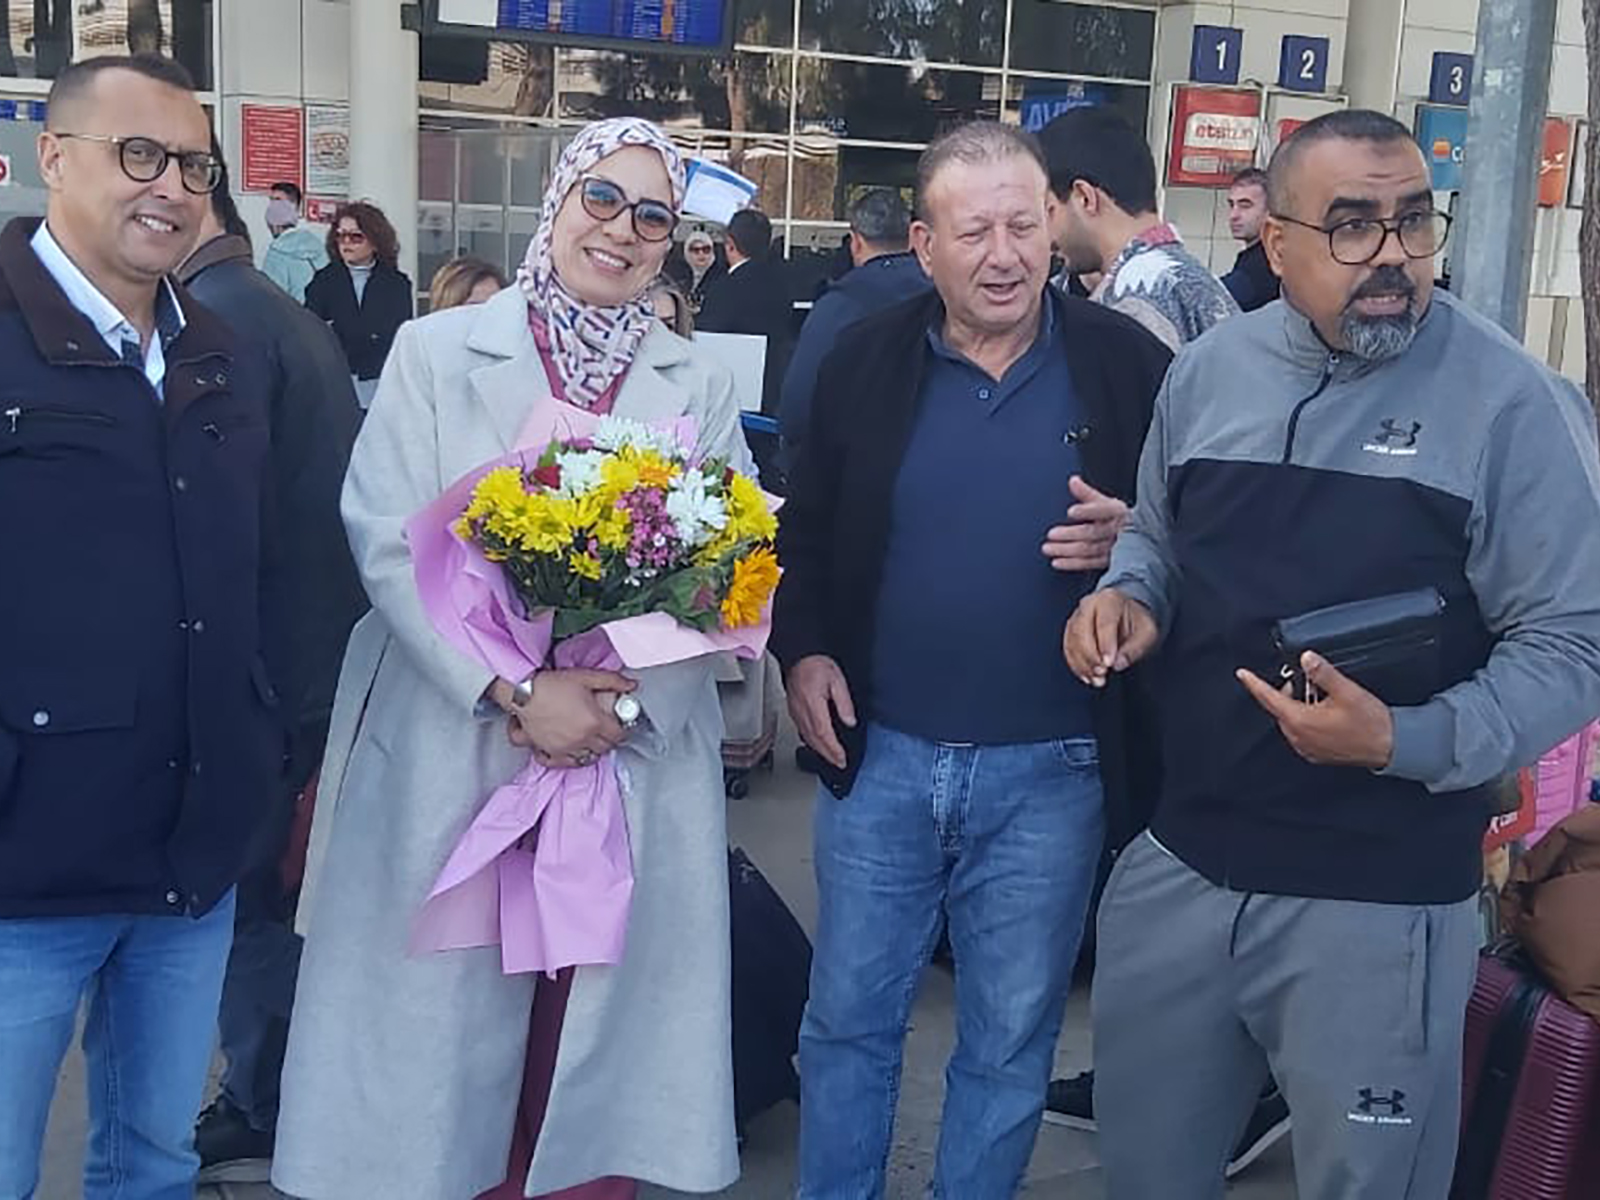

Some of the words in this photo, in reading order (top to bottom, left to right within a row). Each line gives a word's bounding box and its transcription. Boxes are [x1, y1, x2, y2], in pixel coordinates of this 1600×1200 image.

[1216, 40, 1227, 70] 1
[1300, 49, 1315, 78] 2
[1450, 66, 1463, 93] 3
